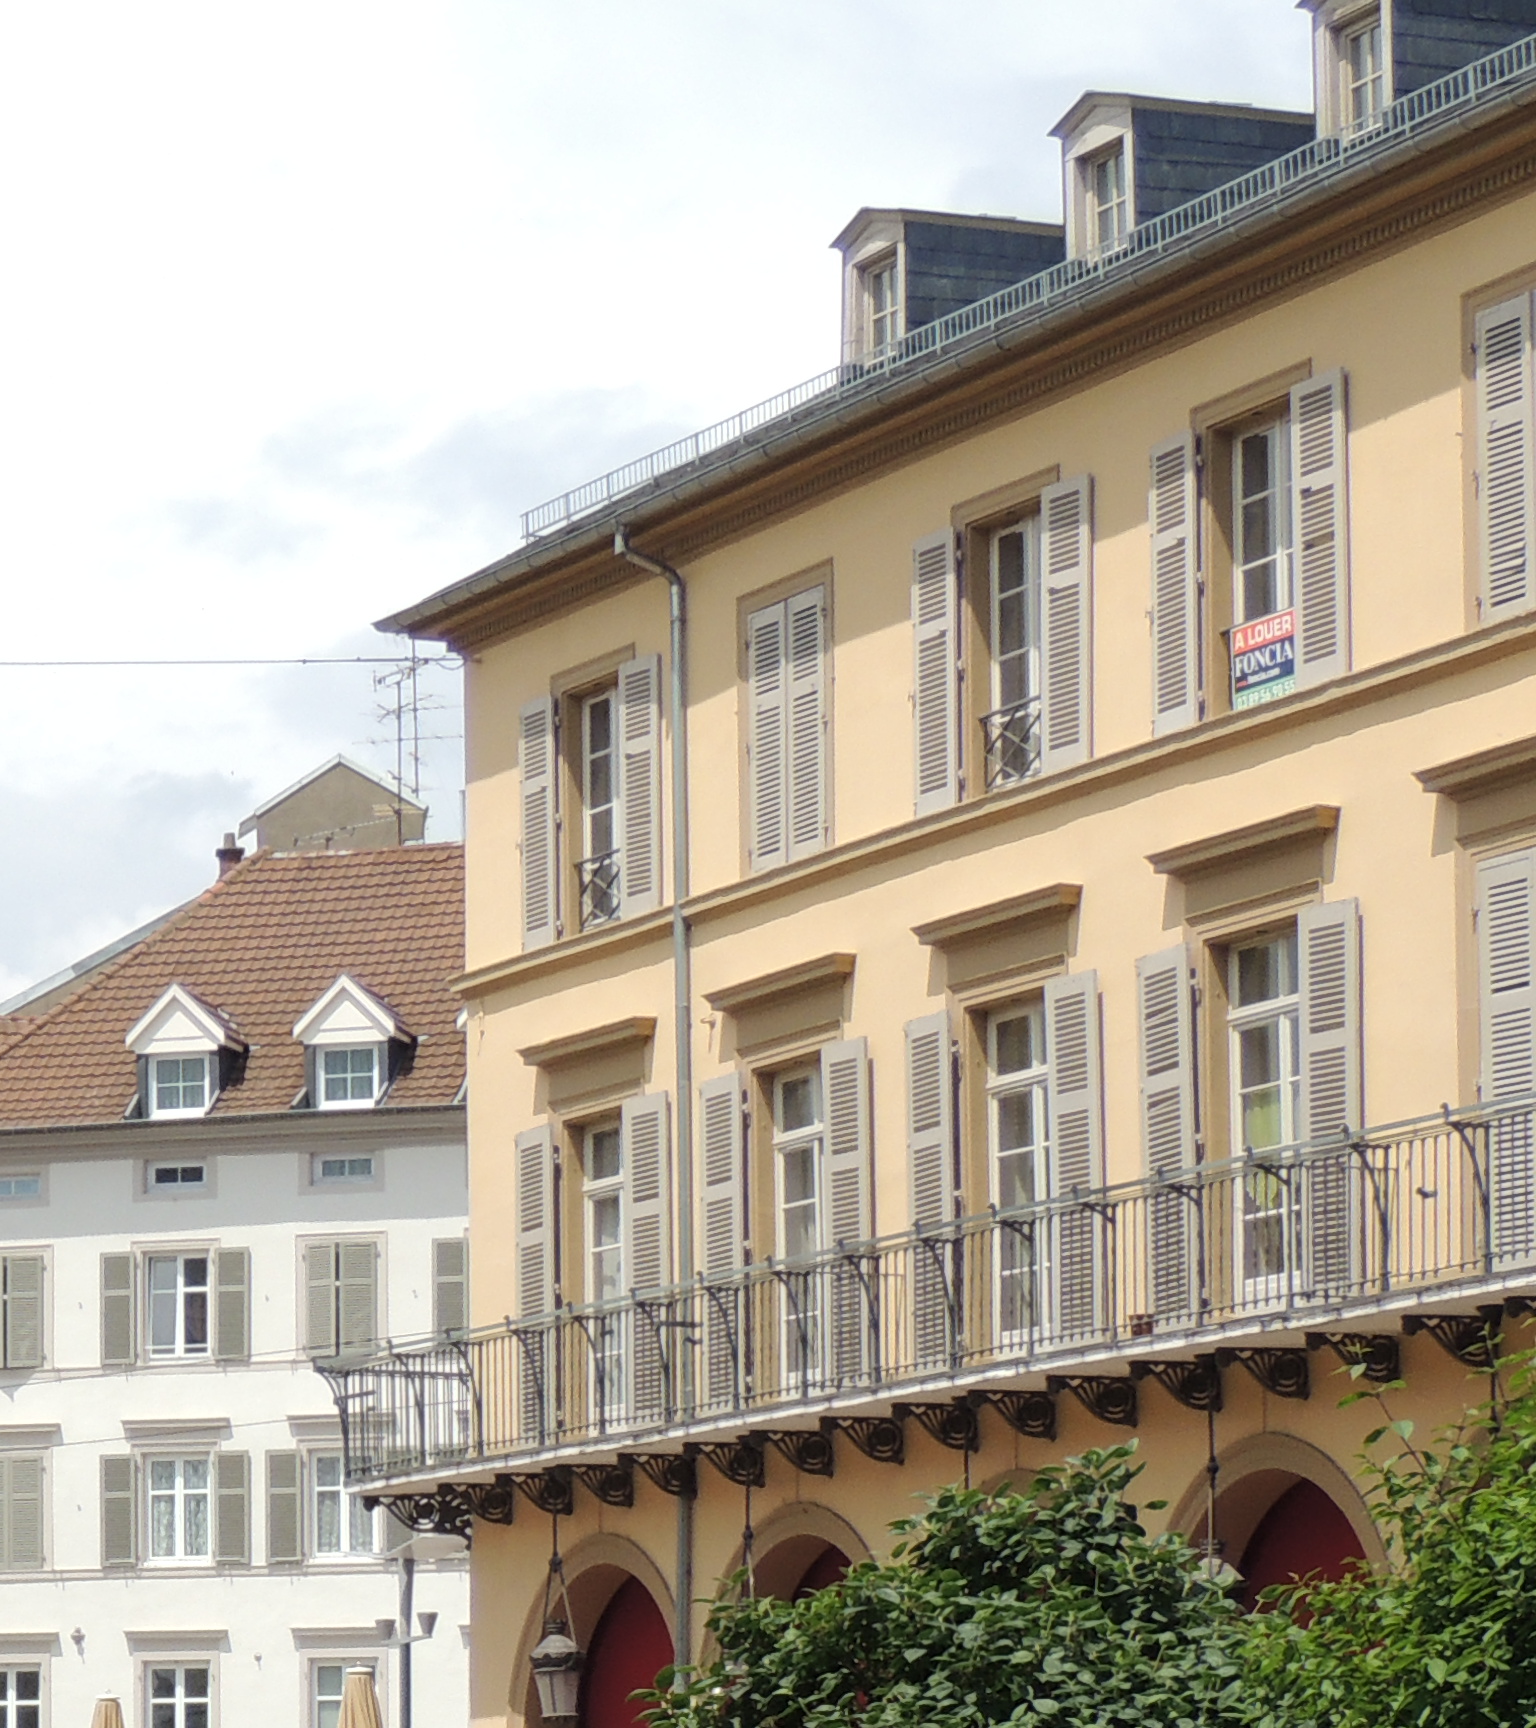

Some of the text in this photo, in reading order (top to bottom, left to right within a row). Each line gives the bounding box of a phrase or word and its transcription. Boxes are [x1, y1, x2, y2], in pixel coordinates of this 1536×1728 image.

[1234, 615, 1292, 651] A LOUER
[1235, 640, 1294, 677] FONCIA
[1284, 679, 1295, 695] 55
